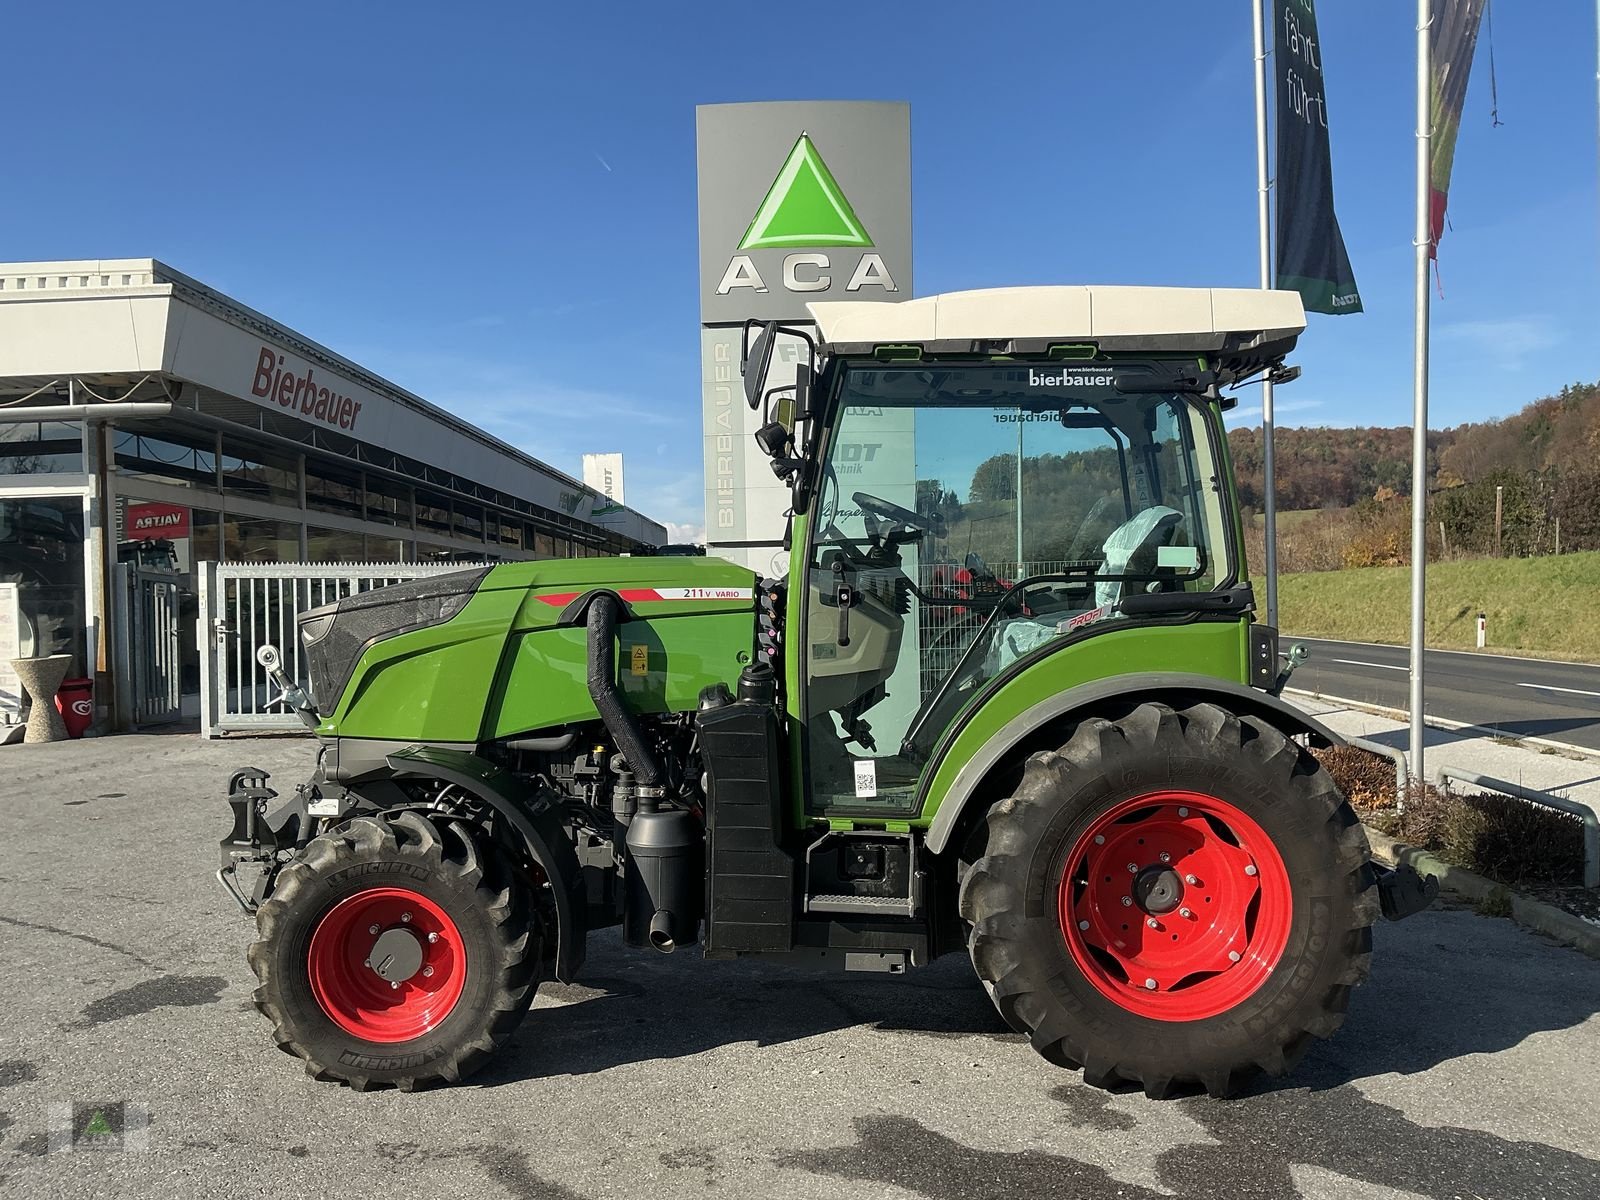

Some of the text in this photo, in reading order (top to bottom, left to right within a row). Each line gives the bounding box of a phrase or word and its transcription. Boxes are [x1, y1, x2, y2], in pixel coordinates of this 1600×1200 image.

[714, 252, 900, 296] ACA
[251, 346, 362, 431] Bierbauer
[1028, 368, 1113, 387] bierbauer
[714, 342, 735, 528] BIERBAUER
[1068, 606, 1104, 629] PROFI
[346, 861, 430, 883] MICHELIN
[340, 1052, 426, 1071] MICHELIN
